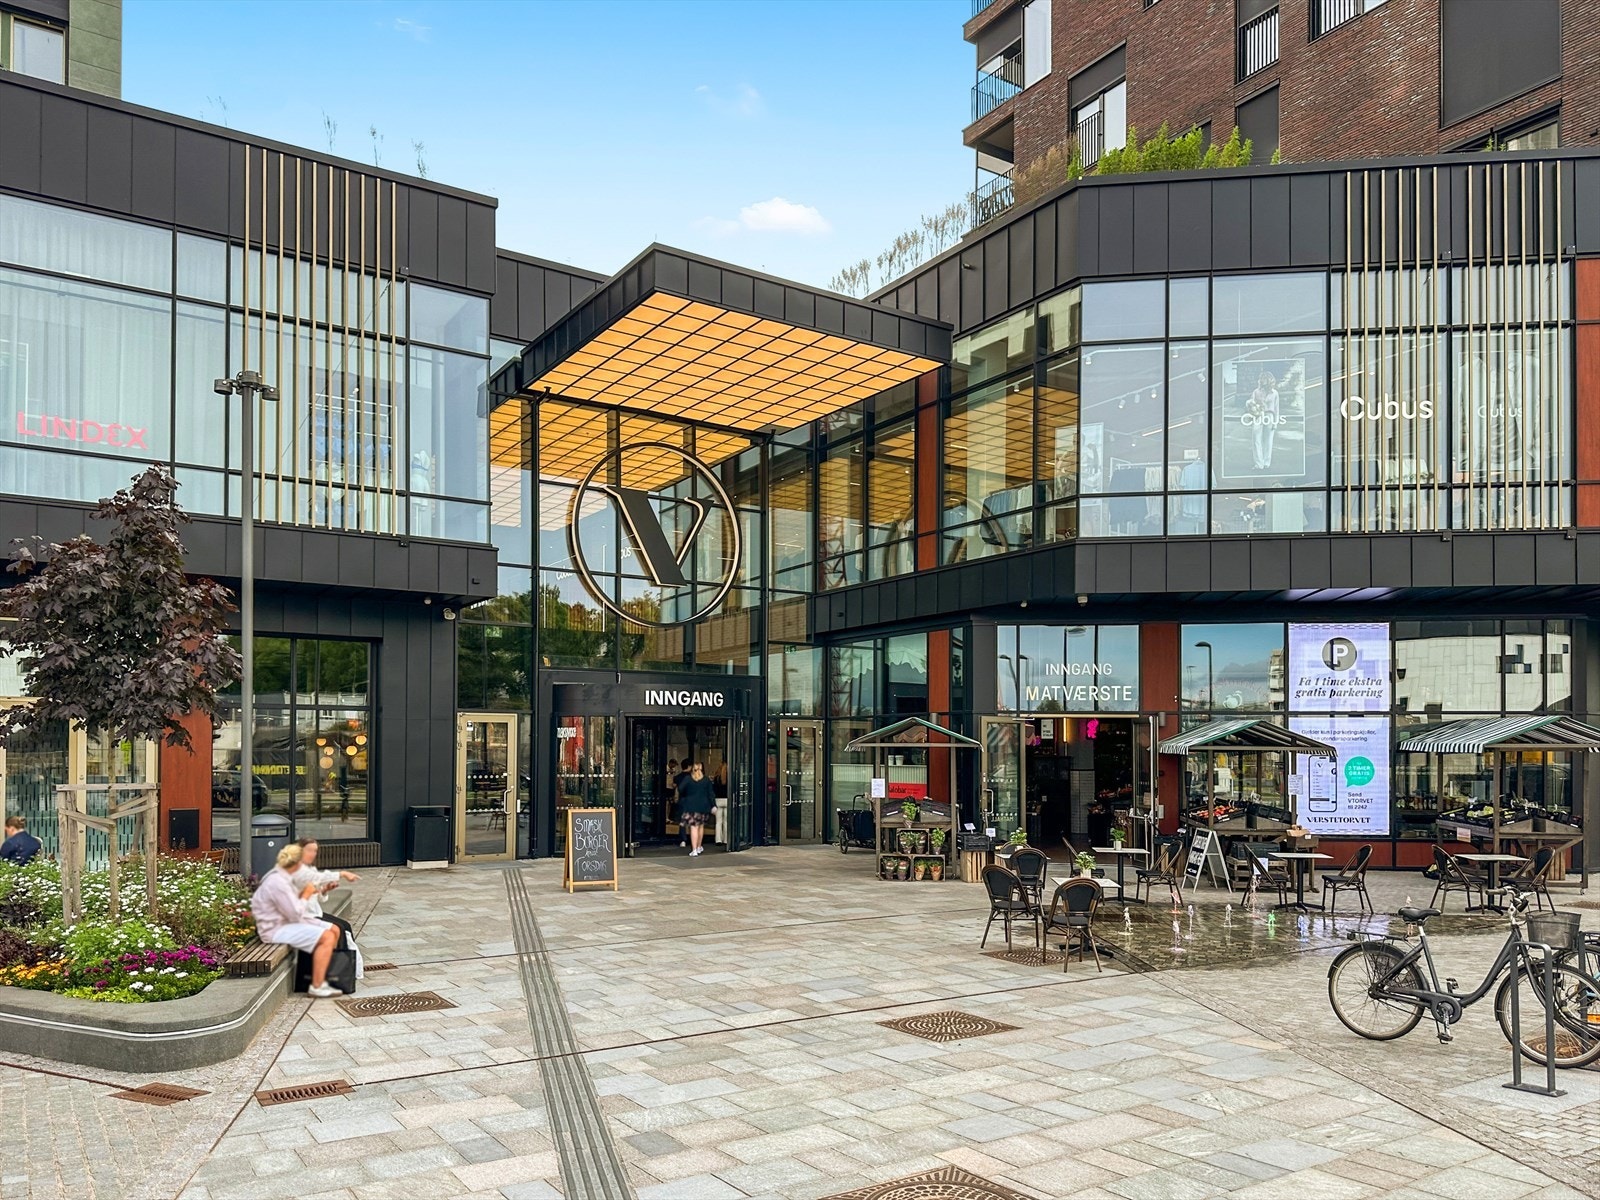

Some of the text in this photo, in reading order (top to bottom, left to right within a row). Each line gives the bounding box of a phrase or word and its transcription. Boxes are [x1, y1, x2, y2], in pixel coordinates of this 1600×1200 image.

[1341, 393, 1433, 421] Cubus
[1241, 411, 1287, 426] Cubus
[17, 411, 148, 450] LINDEX
[603, 485, 715, 588] V
[1333, 644, 1349, 664] P
[1045, 663, 1113, 676] INNGANG
[1322, 677, 1346, 686] time
[1348, 677, 1382, 686] ekstra
[645, 690, 724, 708] INNGANG
[1295, 688, 1383, 698] gratis parkering
